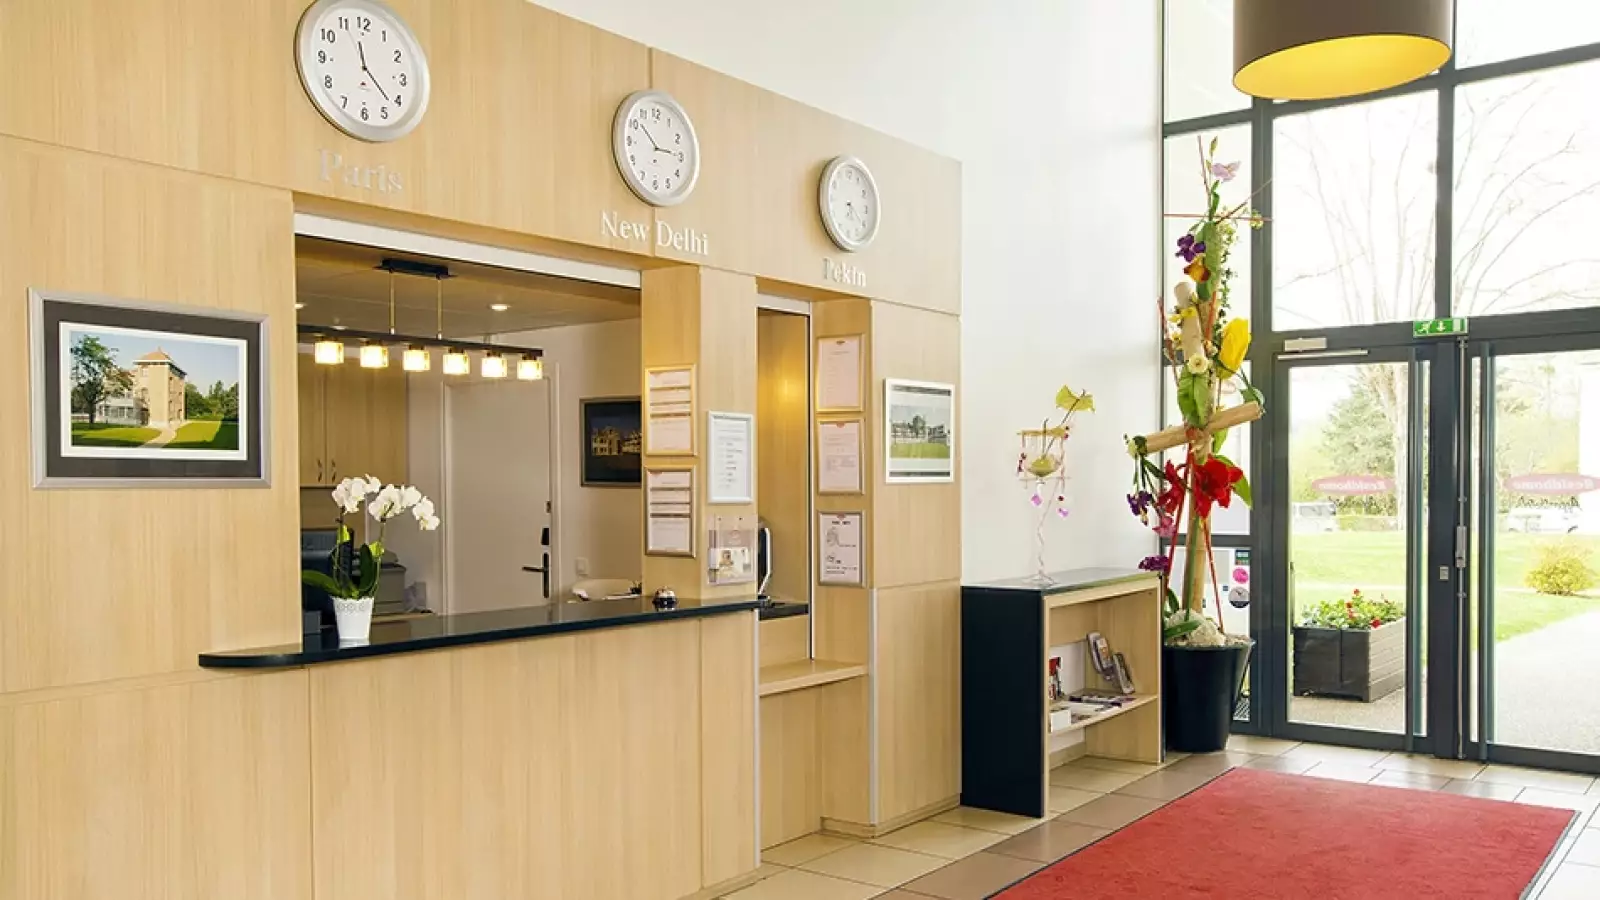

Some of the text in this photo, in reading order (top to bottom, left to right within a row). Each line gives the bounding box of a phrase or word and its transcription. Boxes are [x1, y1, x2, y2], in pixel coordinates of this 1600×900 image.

[339, 16, 349, 31] 11
[357, 16, 371, 32] 12
[321, 28, 336, 43] 10
[381, 30, 387, 42] 1
[318, 50, 326, 64] 9
[394, 49, 401, 63] 2
[325, 75, 332, 88] 8
[399, 73, 407, 87] 3
[340, 95, 348, 109] 7
[394, 94, 402, 107] 4
[361, 108, 369, 121] 6
[381, 106, 388, 120] 5
[652, 108, 661, 120] 12
[629, 118, 639, 130] 10
[675, 133, 682, 145] 2
[317, 149, 402, 194] Paris
[600, 210, 708, 256] New Delhi
